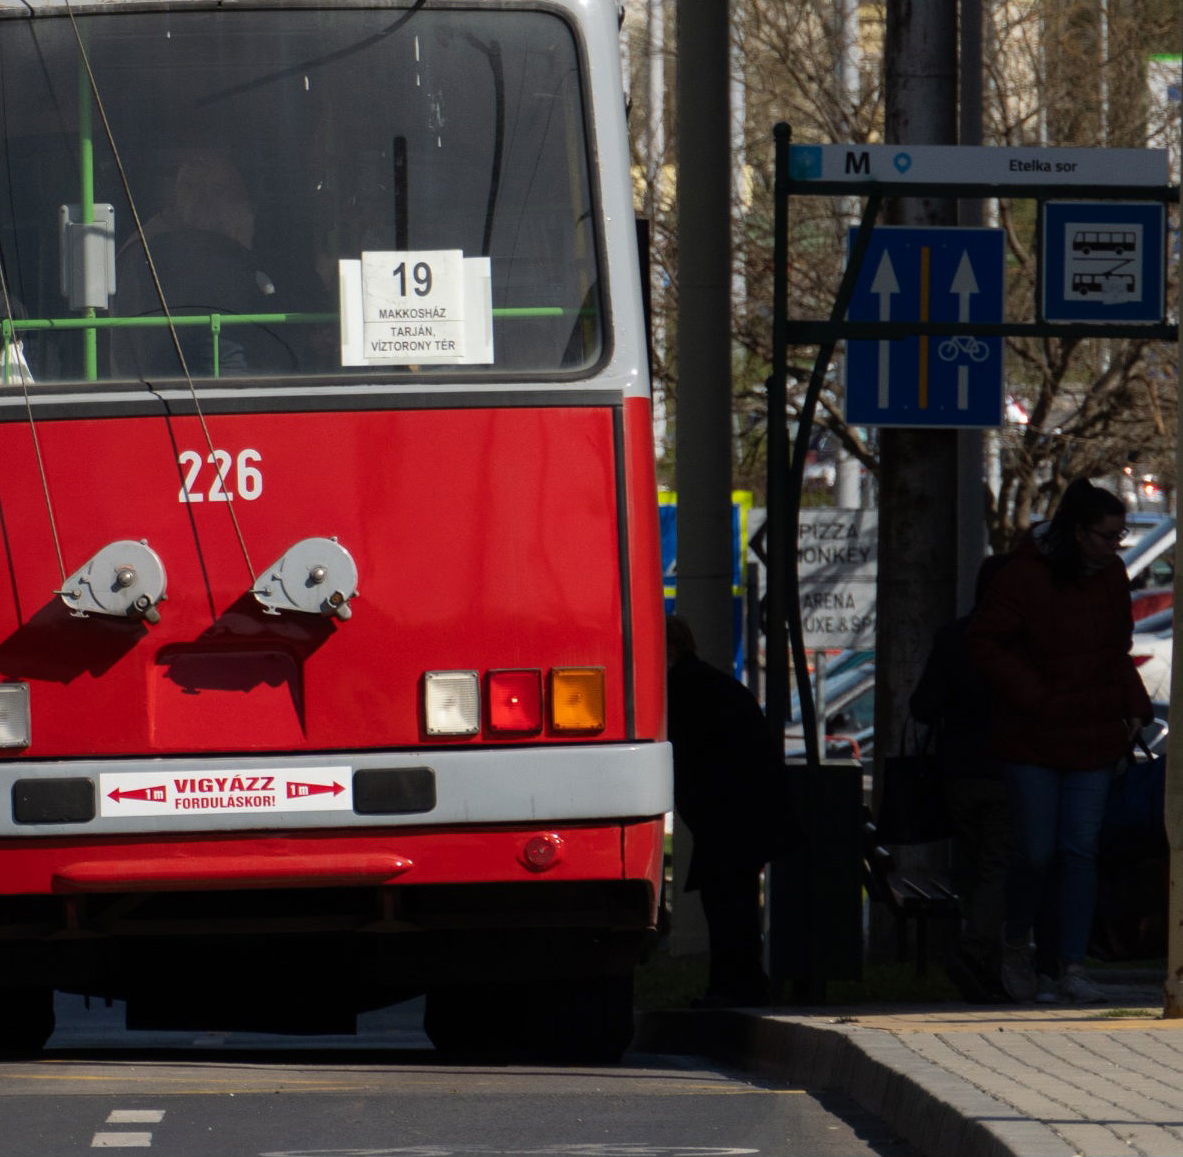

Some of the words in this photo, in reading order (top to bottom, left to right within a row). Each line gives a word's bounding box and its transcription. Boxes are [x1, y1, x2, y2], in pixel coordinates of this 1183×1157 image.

[845, 152, 871, 175] M
[1009, 159, 1052, 172] Etelka
[1055, 162, 1078, 173] sor
[393, 262, 433, 297] 19
[379, 305, 447, 319] MAKKOSHÁZ
[390, 323, 436, 337] TARJÁN,
[371, 338, 432, 351] VÍZTORONY
[435, 337, 456, 351] TÉR
[178, 449, 263, 503] 226
[799, 523, 859, 540] PIZZA
[803, 593, 856, 610] ARENA
[837, 617, 849, 632] &
[174, 774, 275, 793] VIGYÁZZ
[175, 795, 276, 809] FORDULÁSKOR!
